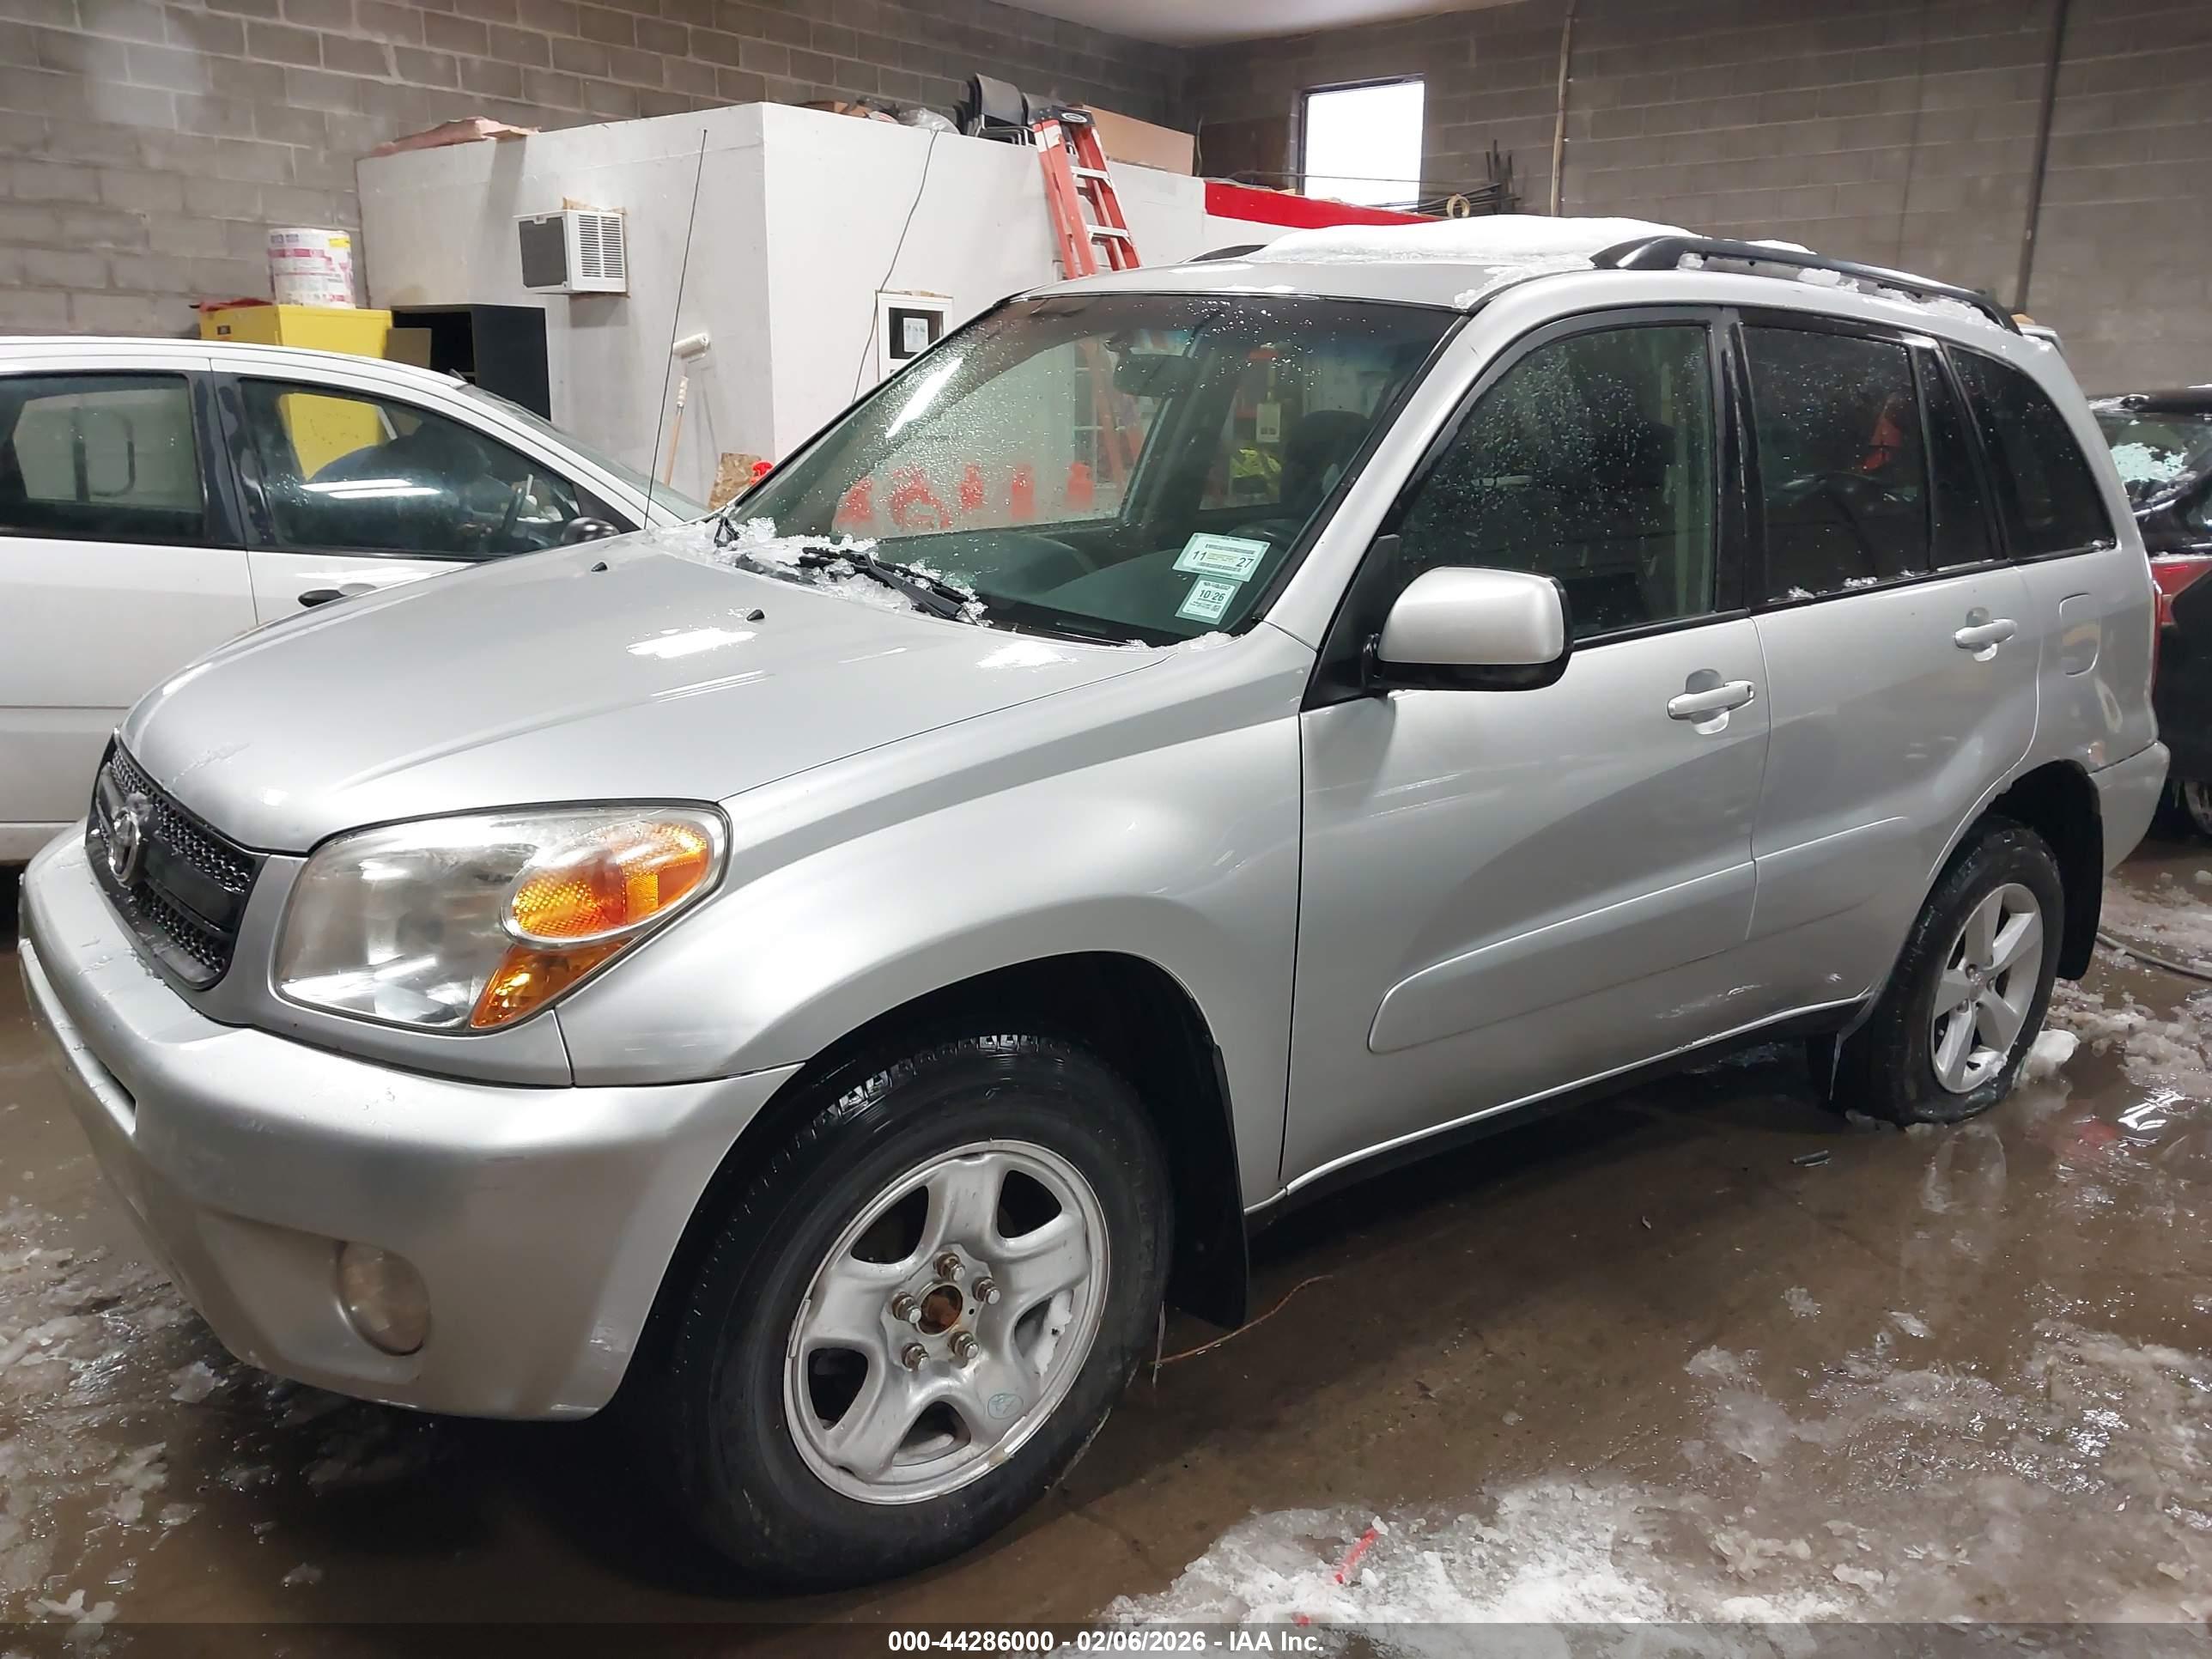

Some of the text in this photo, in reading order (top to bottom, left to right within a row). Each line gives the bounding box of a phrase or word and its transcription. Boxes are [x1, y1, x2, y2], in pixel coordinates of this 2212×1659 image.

[1193, 550, 1206, 561] 11
[1236, 557, 1255, 568] 27
[1199, 589, 1211, 599] 10
[1212, 592, 1226, 602] 26
